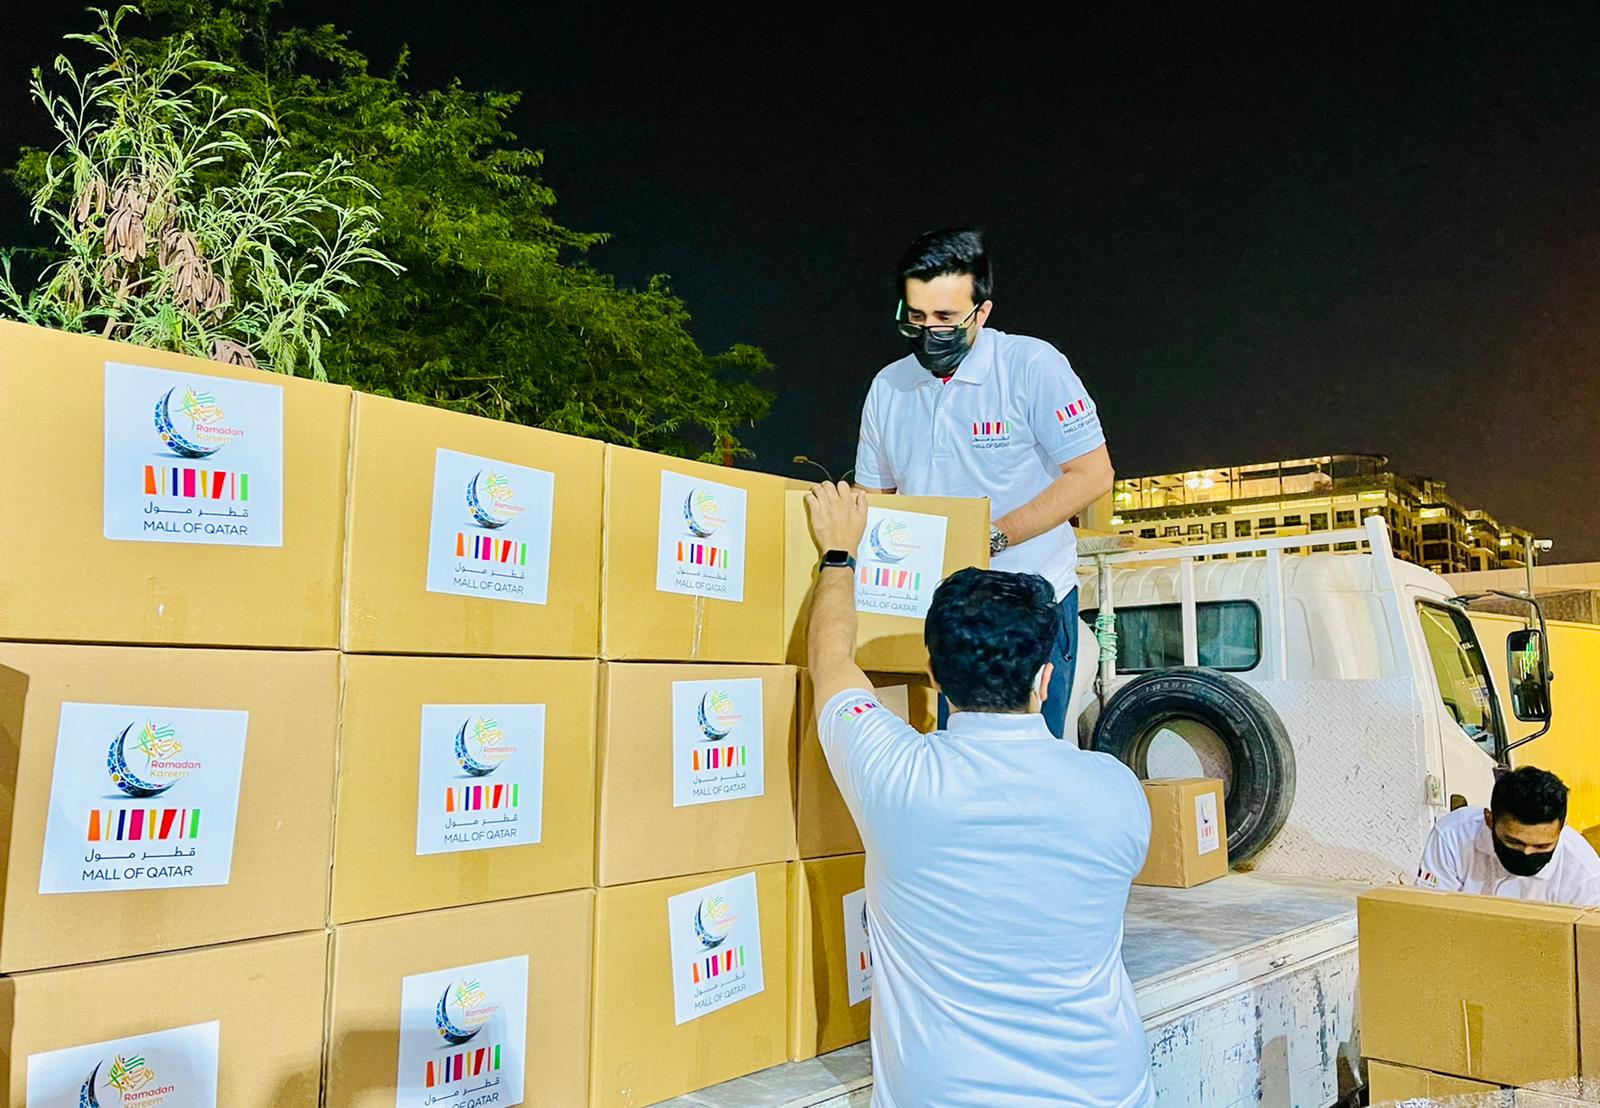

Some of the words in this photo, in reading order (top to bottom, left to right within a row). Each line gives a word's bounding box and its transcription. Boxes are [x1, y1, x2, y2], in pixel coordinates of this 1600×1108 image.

[197, 424, 244, 436] Ramadan
[144, 501, 192, 514] مول
[198, 507, 248, 518] قطر
[144, 521, 180, 532] MALL
[183, 522, 201, 533] OF
[204, 524, 248, 535] QATAR
[453, 578, 478, 588] MALL
[480, 581, 493, 590] OF
[494, 582, 524, 594] QATAR
[676, 578, 694, 588] MALL
[695, 581, 706, 589] OF
[706, 583, 727, 593] QATAR
[858, 599, 879, 609] MALL
[879, 601, 890, 609] OF
[891, 602, 917, 612] QATAR
[151, 760, 201, 769] Ramadan
[150, 769, 188, 778] Kareem
[693, 788, 712, 797] MALL
[713, 786, 723, 795] OF
[723, 783, 746, 793] QATAR
[444, 834, 469, 844] MALL
[471, 832, 486, 841] OF
[486, 829, 517, 840] QATAR
[85, 849, 135, 863] مول
[141, 846, 195, 860] قطر
[82, 869, 120, 881] MALL
[124, 868, 144, 879] OF
[146, 866, 193, 878] QATAR
[694, 998, 713, 1010] MALL
[714, 994, 724, 1003] OF
[724, 984, 746, 999] QATAR
[124, 1085, 175, 1101] Ramadan
[467, 1092, 499, 1108] QATAR
